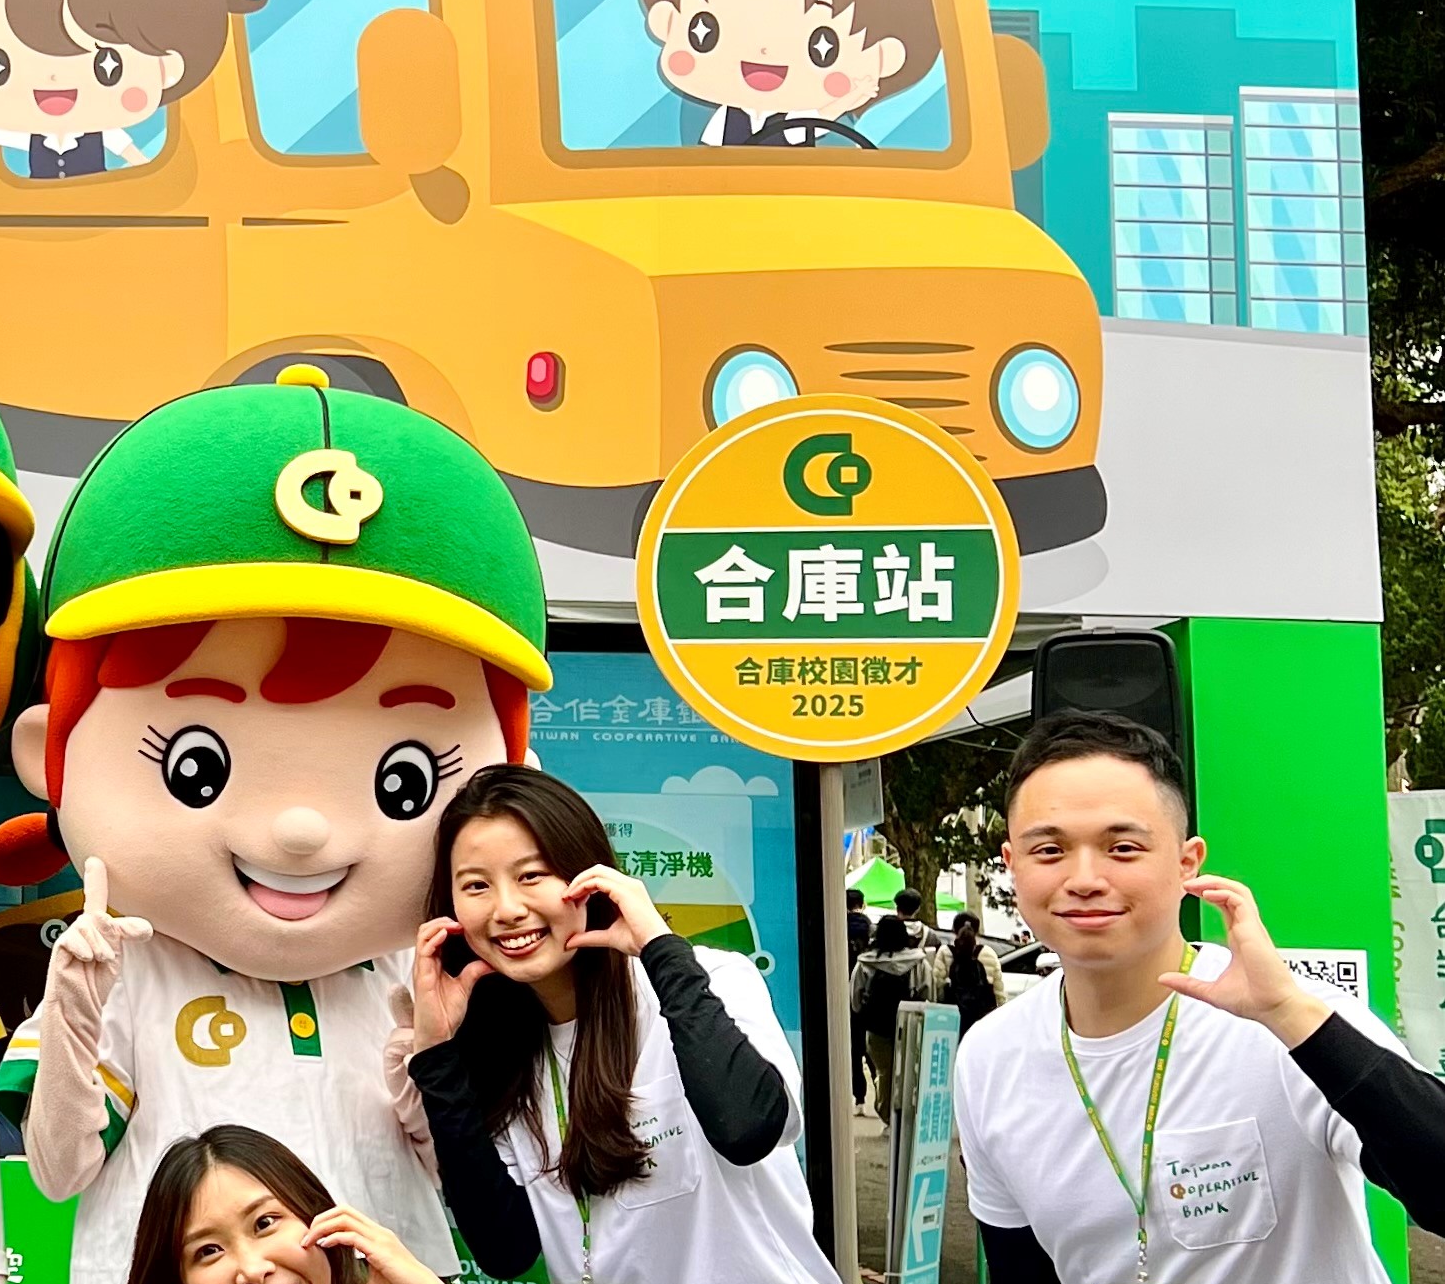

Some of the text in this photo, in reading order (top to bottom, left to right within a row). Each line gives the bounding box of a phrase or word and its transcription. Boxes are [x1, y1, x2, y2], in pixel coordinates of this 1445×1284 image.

[693, 542, 955, 623] 合庫站
[734, 656, 924, 686] 合庫校園徵才
[791, 694, 865, 717] 2025
[530, 731, 580, 741] AIWAN
[592, 732, 697, 743] COOPERATIVE
[1167, 1160, 1232, 1178] Taiwan
[1183, 1201, 1229, 1218] BANK
